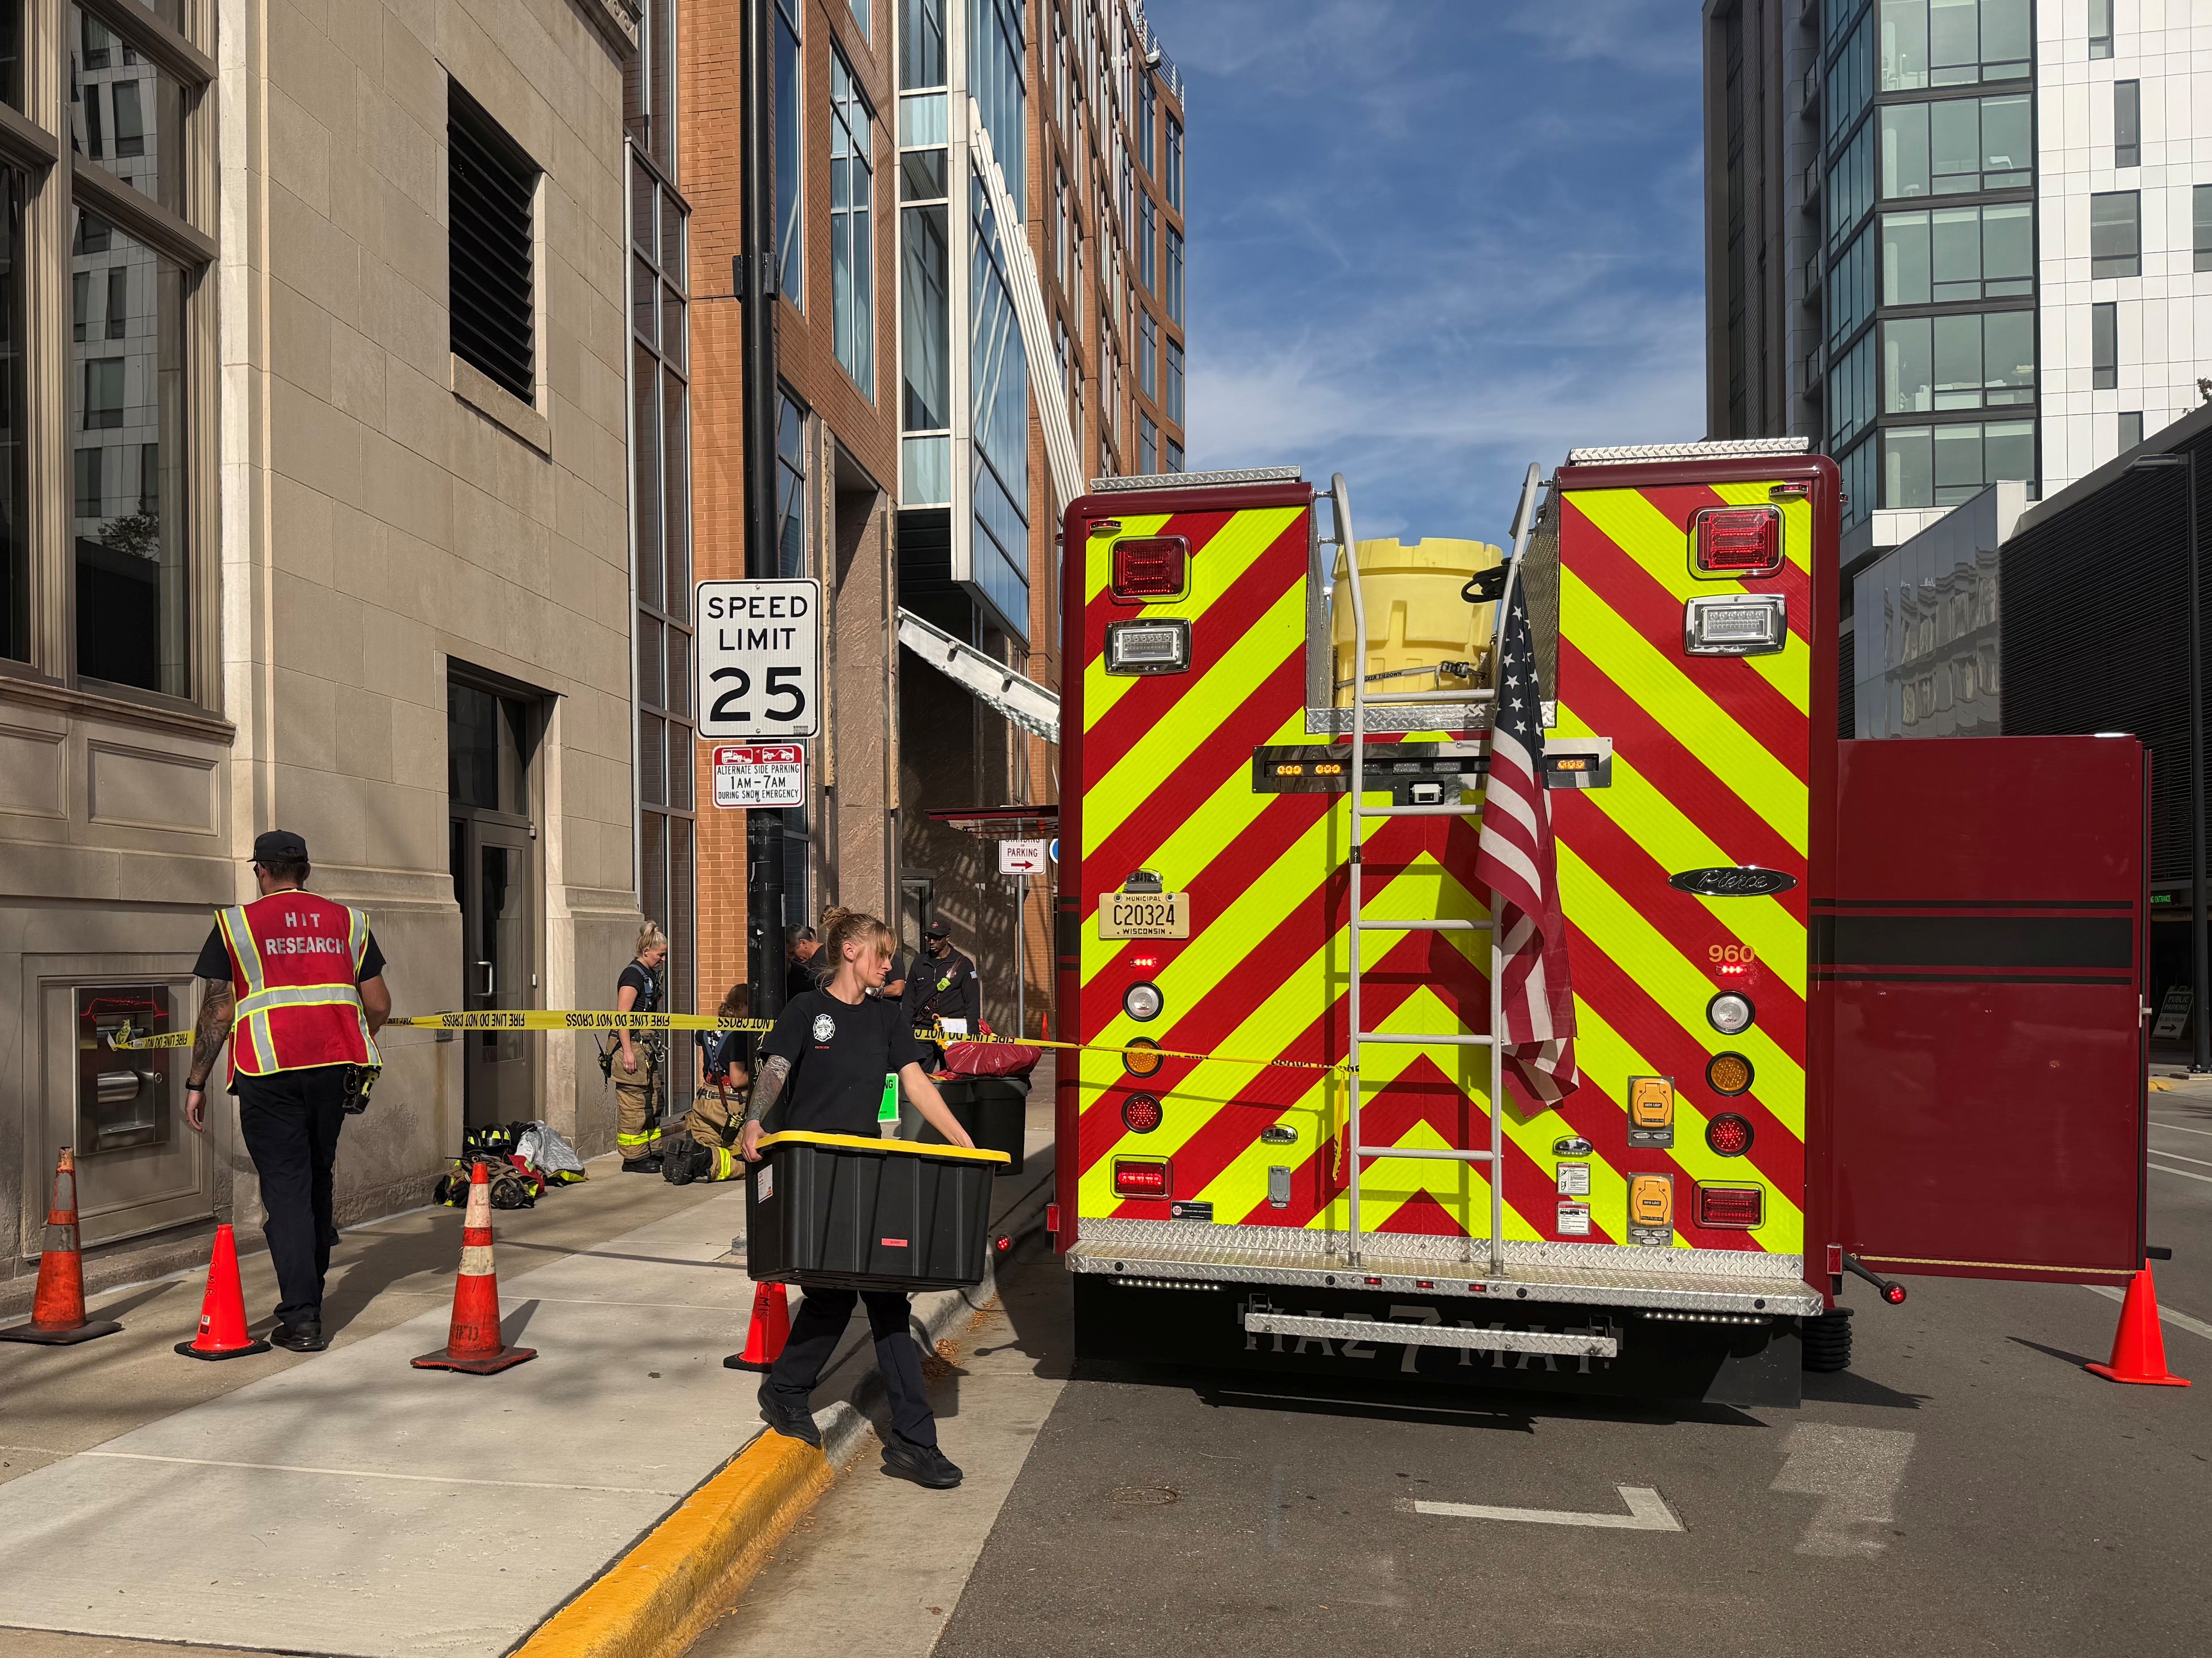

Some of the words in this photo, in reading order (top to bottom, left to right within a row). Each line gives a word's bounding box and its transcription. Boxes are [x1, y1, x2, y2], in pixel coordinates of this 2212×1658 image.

[708, 596, 807, 618] SPEED
[719, 628, 796, 650] LIMIT
[709, 666, 805, 722] 25
[717, 765, 751, 775] ALTERNATE
[754, 764, 768, 774] SIDE
[771, 764, 799, 773] PARKING
[742, 790, 760, 799] SNOW
[762, 789, 799, 798] EMERGENCY
[1008, 848, 1038, 857] PARKING
[1696, 870, 1767, 890] Pierce
[1114, 904, 1175, 925] C20324
[265, 936, 344, 955] RESEARCH
[1708, 945, 1755, 962] 960
[442, 1014, 464, 1027] CROSS
[465, 1013, 478, 1027] NOT
[480, 1013, 490, 1027] DO
[492, 1013, 507, 1027] LINE
[509, 1013, 525, 1027] FIRE
[566, 1013, 594, 1026] CROSS
[596, 1014, 613, 1026] NOT
[615, 1014, 627, 1026] DO
[629, 1014, 648, 1026] LINE
[650, 1015, 670, 1026] FIRE
[717, 1017, 749, 1028] CROSS
[751, 1019, 770, 1029] NOT
[175, 1033, 188, 1046] FIRE
[205, 1262, 216, 1297] CMR
[757, 1282, 771, 1319] CMR
[1389, 1304, 1442, 1373] 7
